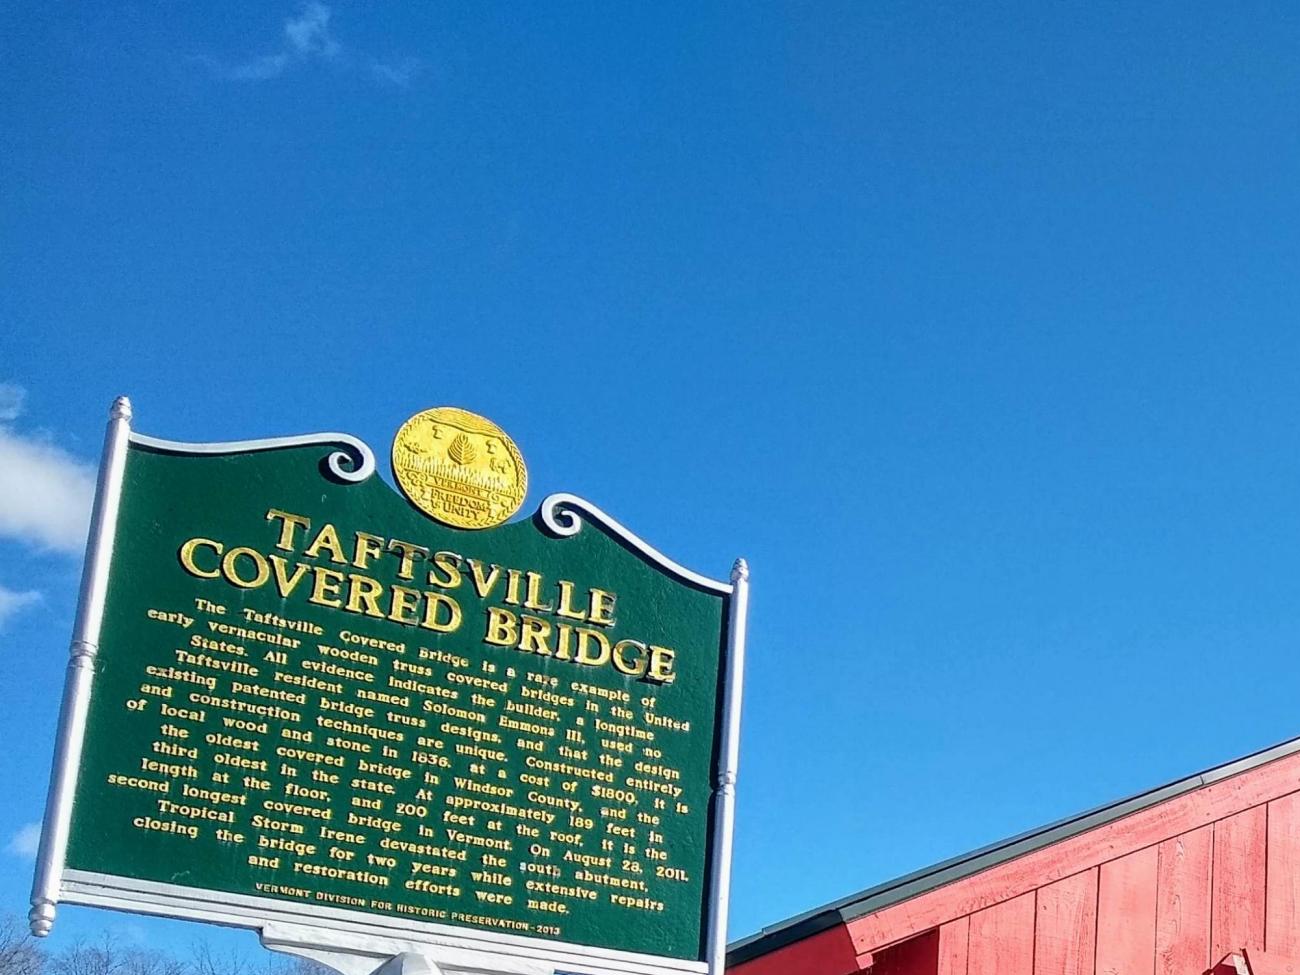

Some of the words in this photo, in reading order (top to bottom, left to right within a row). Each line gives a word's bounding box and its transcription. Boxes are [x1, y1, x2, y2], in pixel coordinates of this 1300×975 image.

[180, 538, 462, 635] COVERED
[485, 606, 676, 685] BRIDGE
[266, 509, 616, 628] TAFTSVILLE
[147, 609, 194, 628] early
[208, 621, 301, 648] vernacular
[317, 644, 378, 665] wooden
[392, 659, 432, 676] truss
[446, 672, 508, 693] covered
[521, 685, 575, 706] bridges
[585, 699, 599, 712] in
[610, 705, 633, 720] the
[645, 711, 690, 731] United
[175, 649, 258, 676] Taftsville
[274, 671, 343, 693] resident
[356, 689, 409, 707] named
[422, 699, 486, 723] Solomon
[498, 715, 555, 737] Emmons
[601, 738, 633, 753] used
[645, 747, 662, 758] no
[190, 634, 248, 656] States.
[263, 650, 287, 664] All
[301, 660, 374, 682] evidence
[388, 675, 458, 699] indicates
[471, 693, 496, 707] the
[575, 716, 584, 726] a
[595, 718, 654, 741] longtime
[195, 598, 226, 614] The
[243, 608, 323, 635] Taftsville
[339, 630, 405, 653] Covered
[418, 647, 468, 667] Bridge
[482, 660, 495, 672] is
[506, 667, 516, 677] a
[527, 672, 558, 689] rare
[571, 682, 630, 704] example
[640, 697, 656, 710] of
[126, 699, 147, 710] of
[160, 703, 205, 722] local
[223, 717, 267, 733] wood
[281, 728, 312, 742] and
[326, 737, 371, 752] stone
[382, 745, 398, 758] in
[469, 763, 485, 774] at
[497, 769, 506, 778] a
[519, 773, 550, 787] cost
[562, 781, 578, 792] of
[654, 797, 665, 809] it
[675, 802, 688, 813] is
[140, 684, 172, 697] and
[189, 693, 300, 722] construction
[316, 715, 403, 741] techniques
[417, 736, 443, 749] are
[455, 744, 508, 762] unique.
[525, 756, 613, 782] Constructed
[625, 777, 682, 799] entirely
[146, 665, 216, 689] existing
[231, 681, 306, 704] patented
[319, 697, 374, 718] bridge
[386, 711, 426, 727] truss
[516, 738, 544, 752] and
[558, 745, 588, 760] that
[599, 753, 622, 767] the
[634, 761, 680, 780] design
[160, 724, 188, 738] the
[205, 733, 259, 751] oldest
[276, 746, 344, 767] covered
[358, 759, 411, 779] bridge
[424, 771, 439, 784] in
[454, 776, 514, 797] Windsor
[600, 806, 626, 819] and
[636, 812, 660, 826] the
[107, 774, 169, 792] second
[182, 783, 246, 805] longest
[263, 800, 331, 820] covered
[347, 812, 401, 832] bridge
[418, 824, 433, 837] in
[446, 828, 512, 851] Vermont.
[530, 843, 550, 857] On
[563, 850, 612, 868] August
[141, 757, 197, 777] length
[211, 772, 229, 783] at
[243, 776, 271, 790] the
[351, 797, 381, 810] and
[395, 802, 427, 817] 200
[443, 810, 475, 826] feet
[487, 820, 502, 830] at
[516, 823, 539, 837] the
[601, 838, 614, 851] it
[623, 842, 635, 854] is
[644, 847, 667, 860] the
[153, 741, 197, 759] third
[214, 753, 267, 771] oldest
[280, 763, 296, 776] in
[311, 769, 339, 783] the
[350, 778, 395, 794] state.
[415, 788, 433, 801] At
[445, 795, 555, 824] approximately
[569, 815, 594, 829] 189
[606, 822, 635, 838] feet
[648, 830, 663, 844] in
[157, 799, 234, 822] Tropical
[251, 814, 303, 834] Storm
[319, 826, 365, 844] Irene
[379, 837, 466, 861] devastated
[482, 854, 506, 867] the
[519, 862, 561, 878] south
[133, 816, 198, 838] closing
[215, 829, 244, 843] the
[258, 835, 316, 856] bridge
[329, 846, 355, 860] for
[367, 853, 396, 867] two
[411, 861, 457, 877] years
[471, 870, 512, 886] while
[525, 880, 597, 900] extensive
[610, 894, 664, 911] repairs
[248, 855, 279, 868] and
[294, 862, 388, 886] restoration
[405, 879, 460, 896] efforts
[475, 890, 512, 905] were
[527, 899, 569, 914] made.
[255, 882, 311, 897] VERMONT
[316, 891, 365, 906] DIVISION
[370, 900, 392, 910] FOR
[396, 903, 446, 918] HISTORIC
